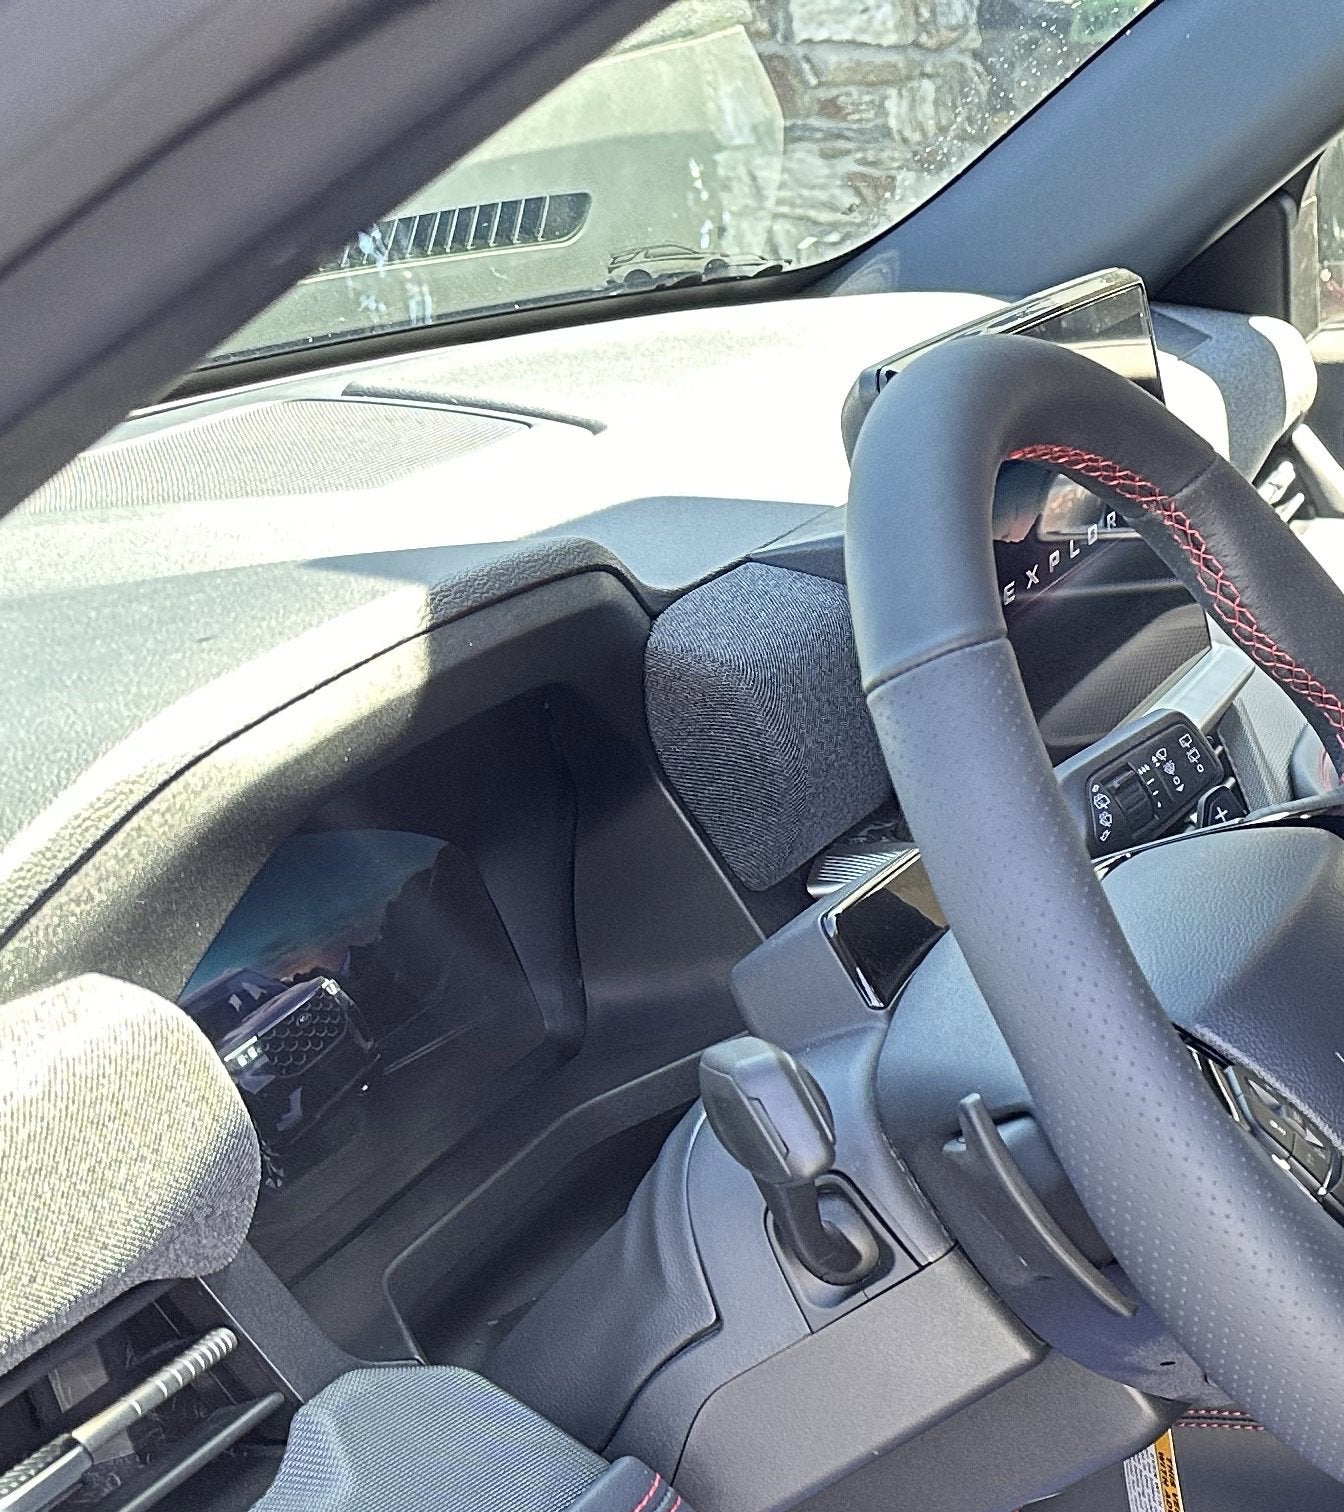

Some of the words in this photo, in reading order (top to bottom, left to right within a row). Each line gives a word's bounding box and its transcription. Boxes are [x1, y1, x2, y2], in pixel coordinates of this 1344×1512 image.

[1004, 511, 1117, 606] EXPLOR
[1158, 1451, 1169, 1487] WITH
[1166, 1457, 1176, 1488] THIS
